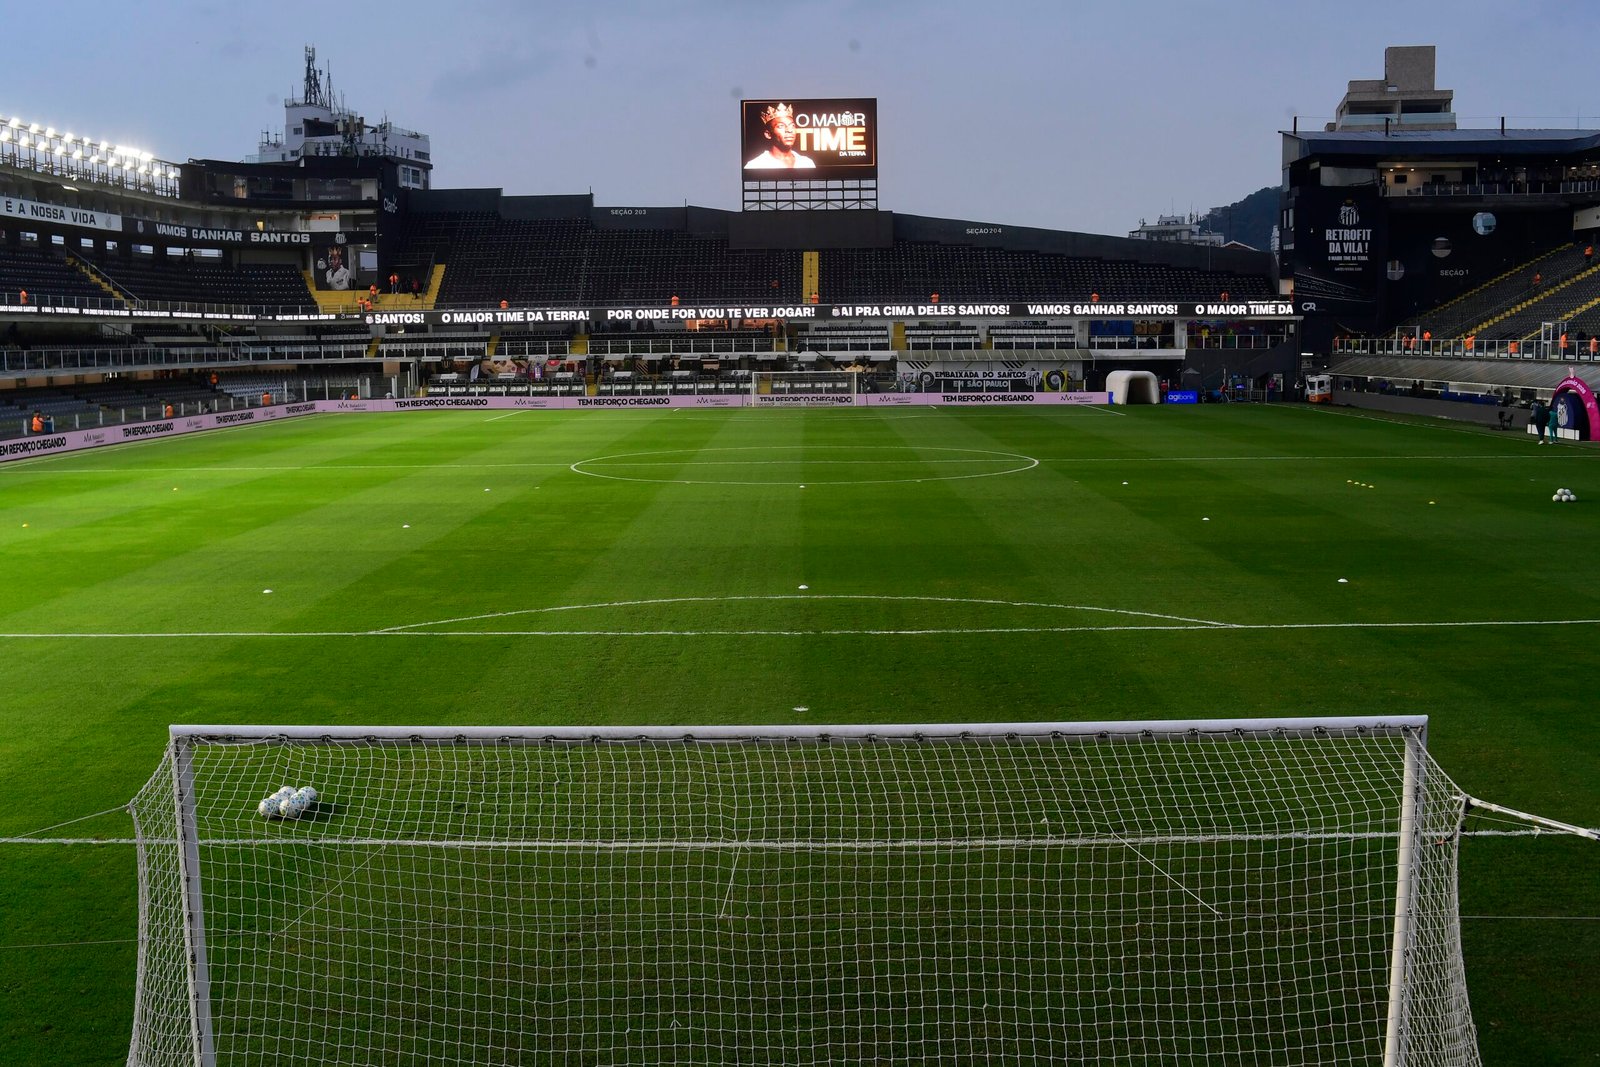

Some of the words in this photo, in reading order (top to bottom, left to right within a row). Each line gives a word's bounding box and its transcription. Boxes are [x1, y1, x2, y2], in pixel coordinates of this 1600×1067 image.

[795, 113, 810, 127] O
[795, 127, 866, 151] TIME
[5, 199, 13, 212] É
[18, 203, 26, 215] A
[31, 204, 66, 220] NOSSA
[71, 211, 97, 225] VIDA
[156, 223, 187, 238] VAMOS
[192, 228, 242, 241] GANHAR
[250, 232, 310, 243] SANTOS
[1325, 229, 1372, 241] RETROFIT
[1329, 242, 1341, 253] DA
[607, 310, 633, 320] POR
[635, 309, 670, 319] ONDE
[672, 309, 696, 319] FOR
[699, 308, 725, 319] VOU
[727, 308, 742, 318] TE
[744, 308, 769, 318] VER
[771, 307, 816, 318] JOGAR!
[857, 306, 881, 317] PRA
[884, 306, 915, 316] CIMA
[918, 305, 956, 316] DELES
[958, 304, 1010, 316] SANTOS!
[1028, 304, 1071, 315] VAMOS
[1073, 304, 1125, 315] GANHAR
[1127, 304, 1178, 315] SANTOS!
[1195, 304, 1205, 315] O
[1207, 304, 1247, 315] MAIOR
[1249, 304, 1276, 315] TIME
[1278, 304, 1294, 315] DA
[375, 313, 425, 324] SANTOS!
[441, 313, 451, 323] O
[453, 312, 493, 323] MAIOR
[496, 312, 525, 322] TIME
[527, 311, 545, 322] DA
[546, 311, 590, 321] TERRA!
[967, 378, 983, 388] SÃO
[985, 380, 1009, 388] PAULO
[395, 400, 410, 408] TEM
[410, 398, 445, 407] REFORÇO
[446, 398, 488, 406] CHEGANDO
[577, 398, 593, 406] TEM
[593, 398, 627, 407] REFORÇO
[628, 397, 670, 405] CHEGANDO
[957, 395, 992, 403] REFORÇO
[993, 394, 1035, 402] CHEGANDO
[1168, 393, 1195, 404] agibank
[122, 427, 131, 438] TEM
[132, 424, 151, 437] REFORÇO
[152, 421, 174, 434] CHEGANDO
[0, 444, 8, 456] EM
[9, 440, 36, 455] REFORÇO
[36, 436, 67, 451] CHEGANDO
